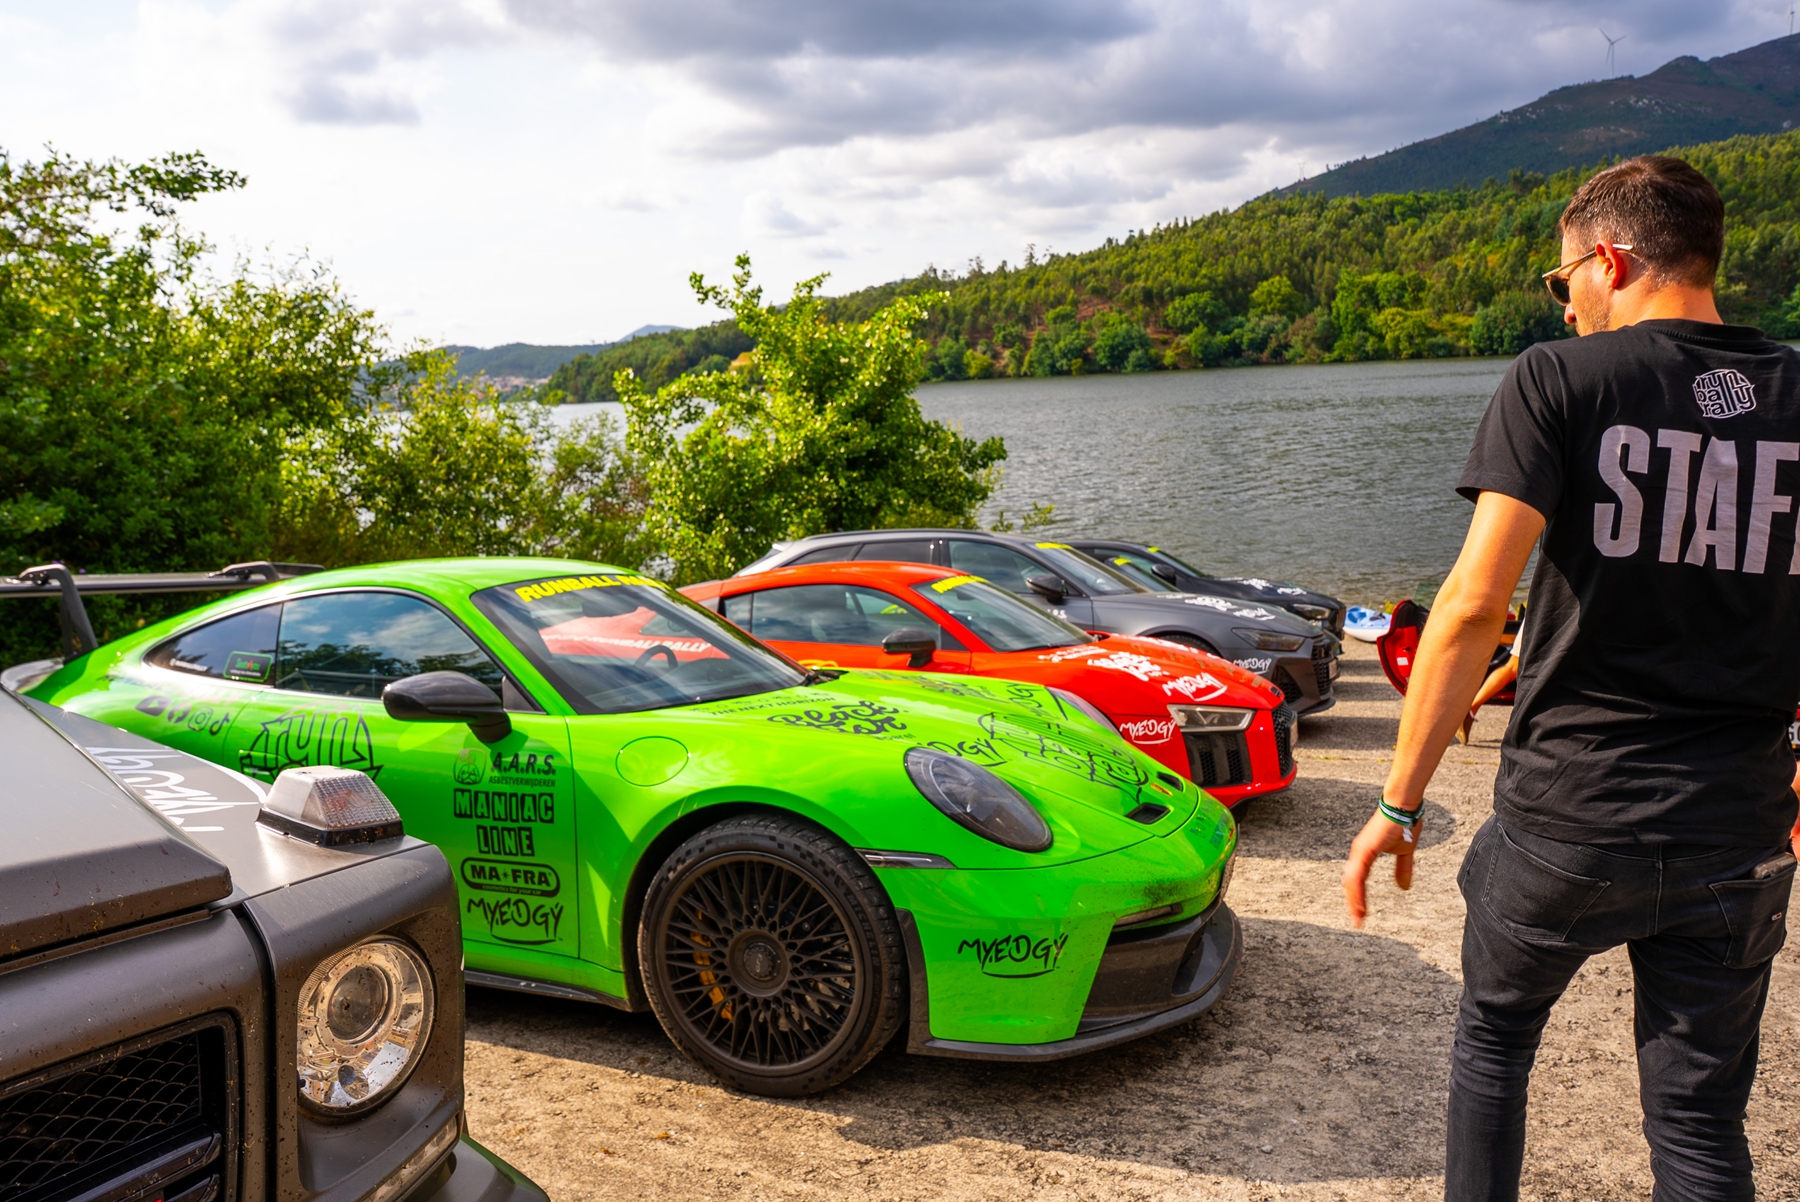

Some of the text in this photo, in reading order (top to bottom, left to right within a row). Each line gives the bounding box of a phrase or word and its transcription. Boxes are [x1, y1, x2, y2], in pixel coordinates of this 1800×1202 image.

[514, 575, 621, 602] RUNBALL
[453, 788, 555, 824] MANIAC
[476, 824, 535, 857] LINE
